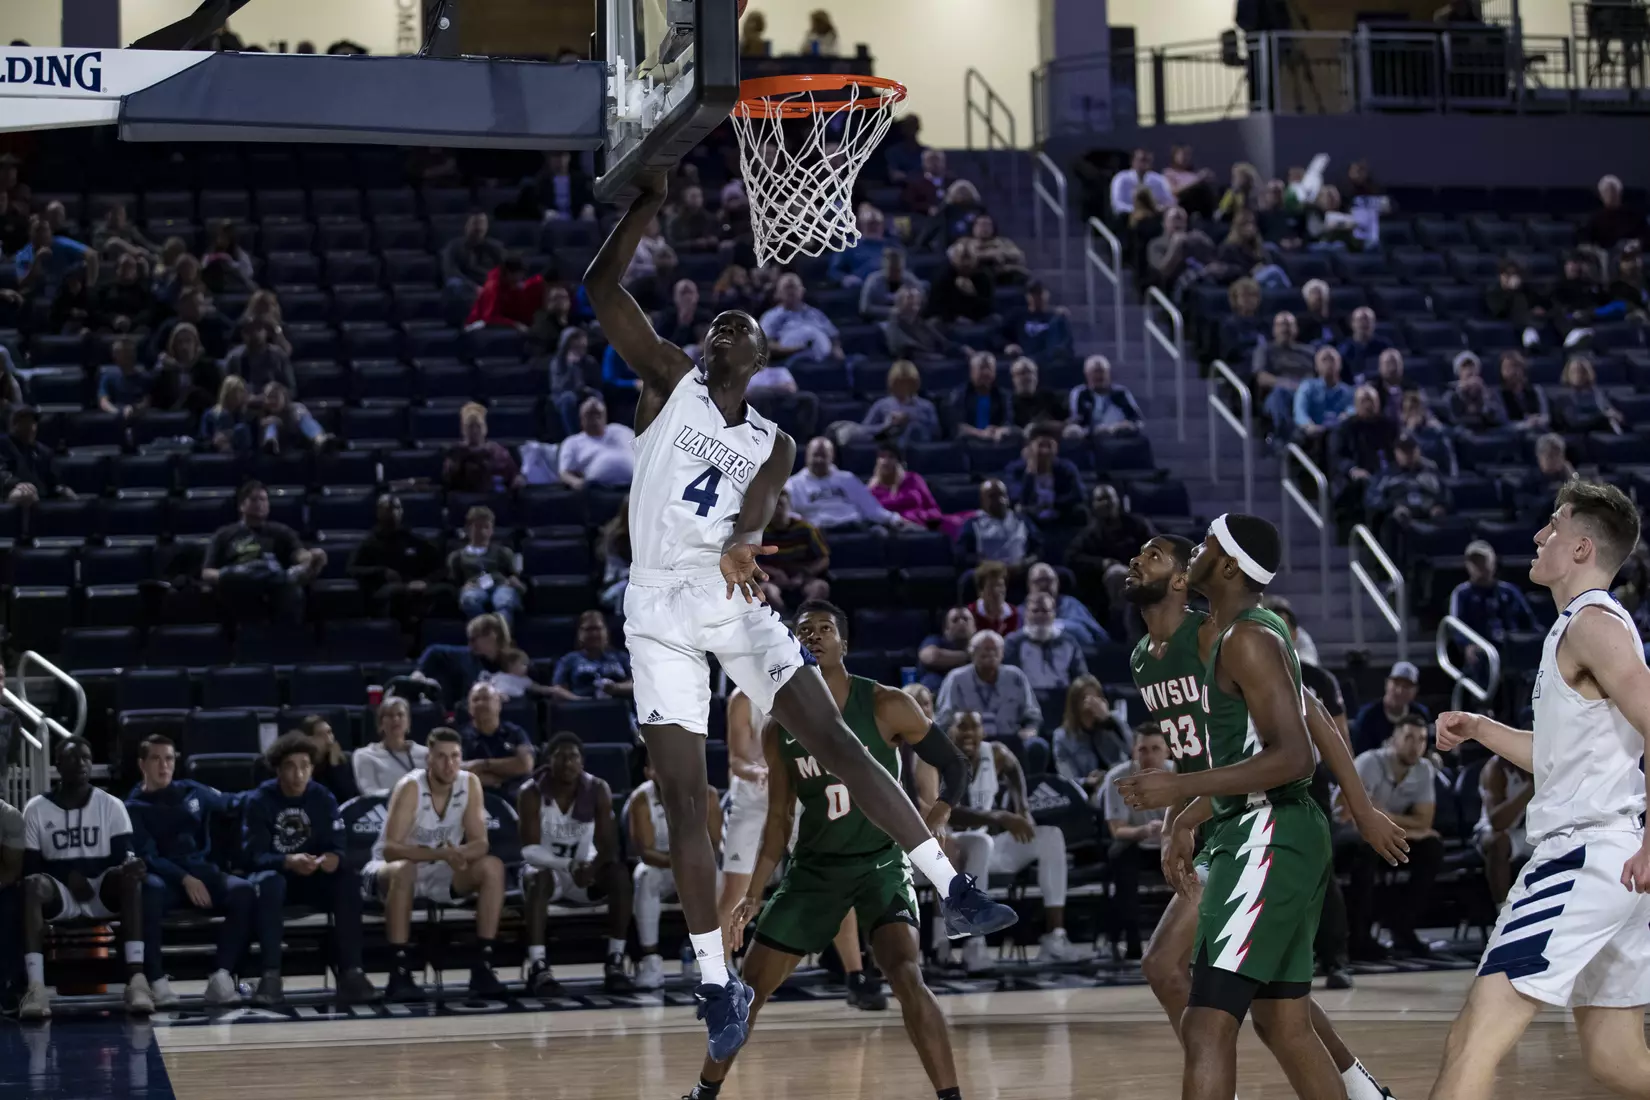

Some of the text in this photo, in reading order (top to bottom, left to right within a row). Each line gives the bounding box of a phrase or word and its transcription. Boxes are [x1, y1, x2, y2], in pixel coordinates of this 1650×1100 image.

[0, 51, 102, 93] DING
[673, 425, 756, 484] LANCERS
[681, 465, 722, 518] 4
[1140, 675, 1200, 712] MVSU
[1160, 714, 1203, 759] 33
[825, 783, 851, 821] 0
[52, 826, 100, 850] CBU
